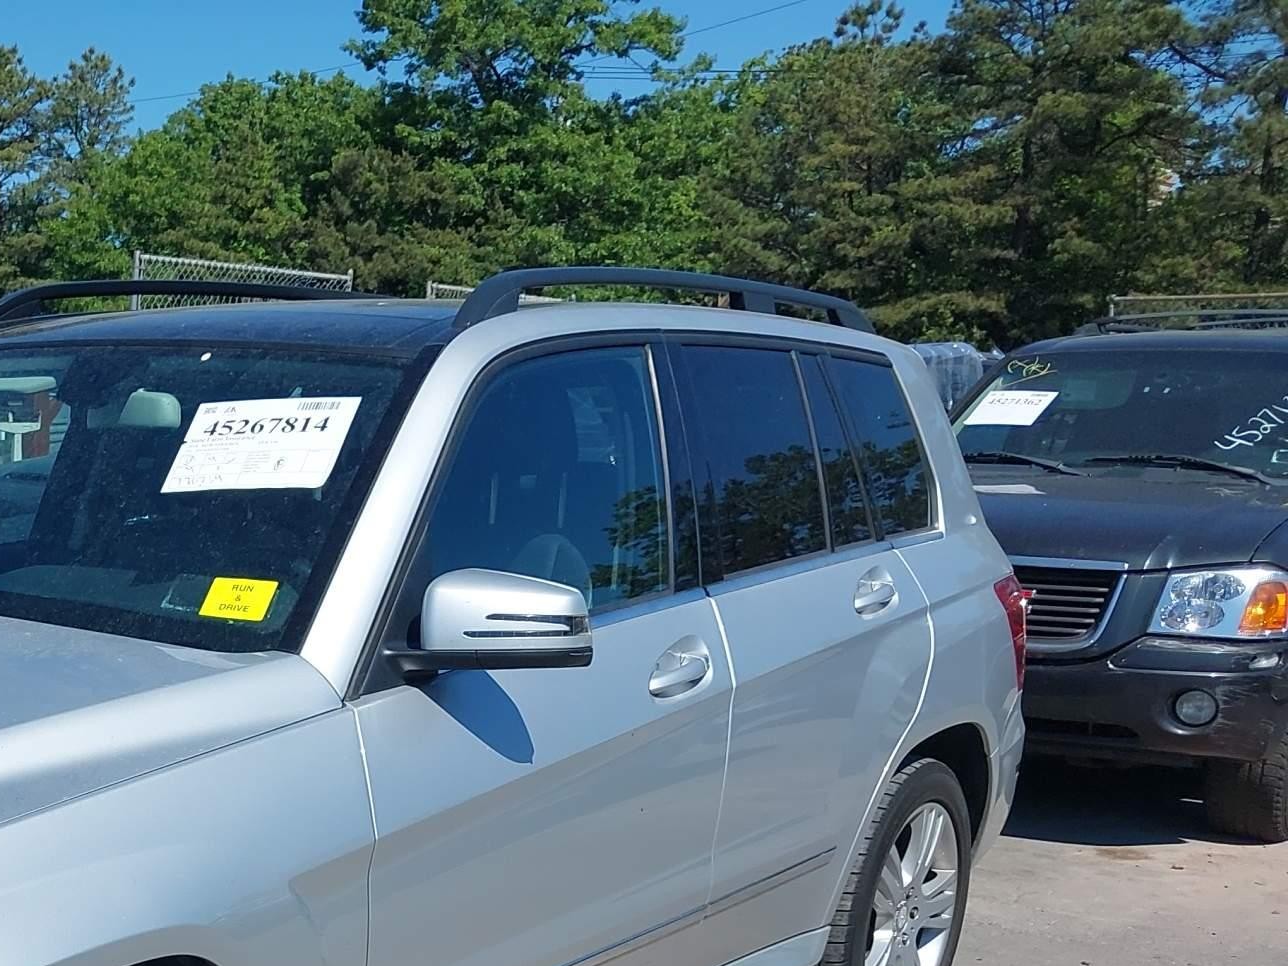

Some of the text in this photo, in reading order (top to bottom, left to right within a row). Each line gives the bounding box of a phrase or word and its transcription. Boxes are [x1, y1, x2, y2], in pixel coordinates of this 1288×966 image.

[203, 416, 330, 436] 45267814
[232, 584, 254, 592] RUN
[234, 594, 242, 602] &
[218, 603, 250, 613] DRIVE
